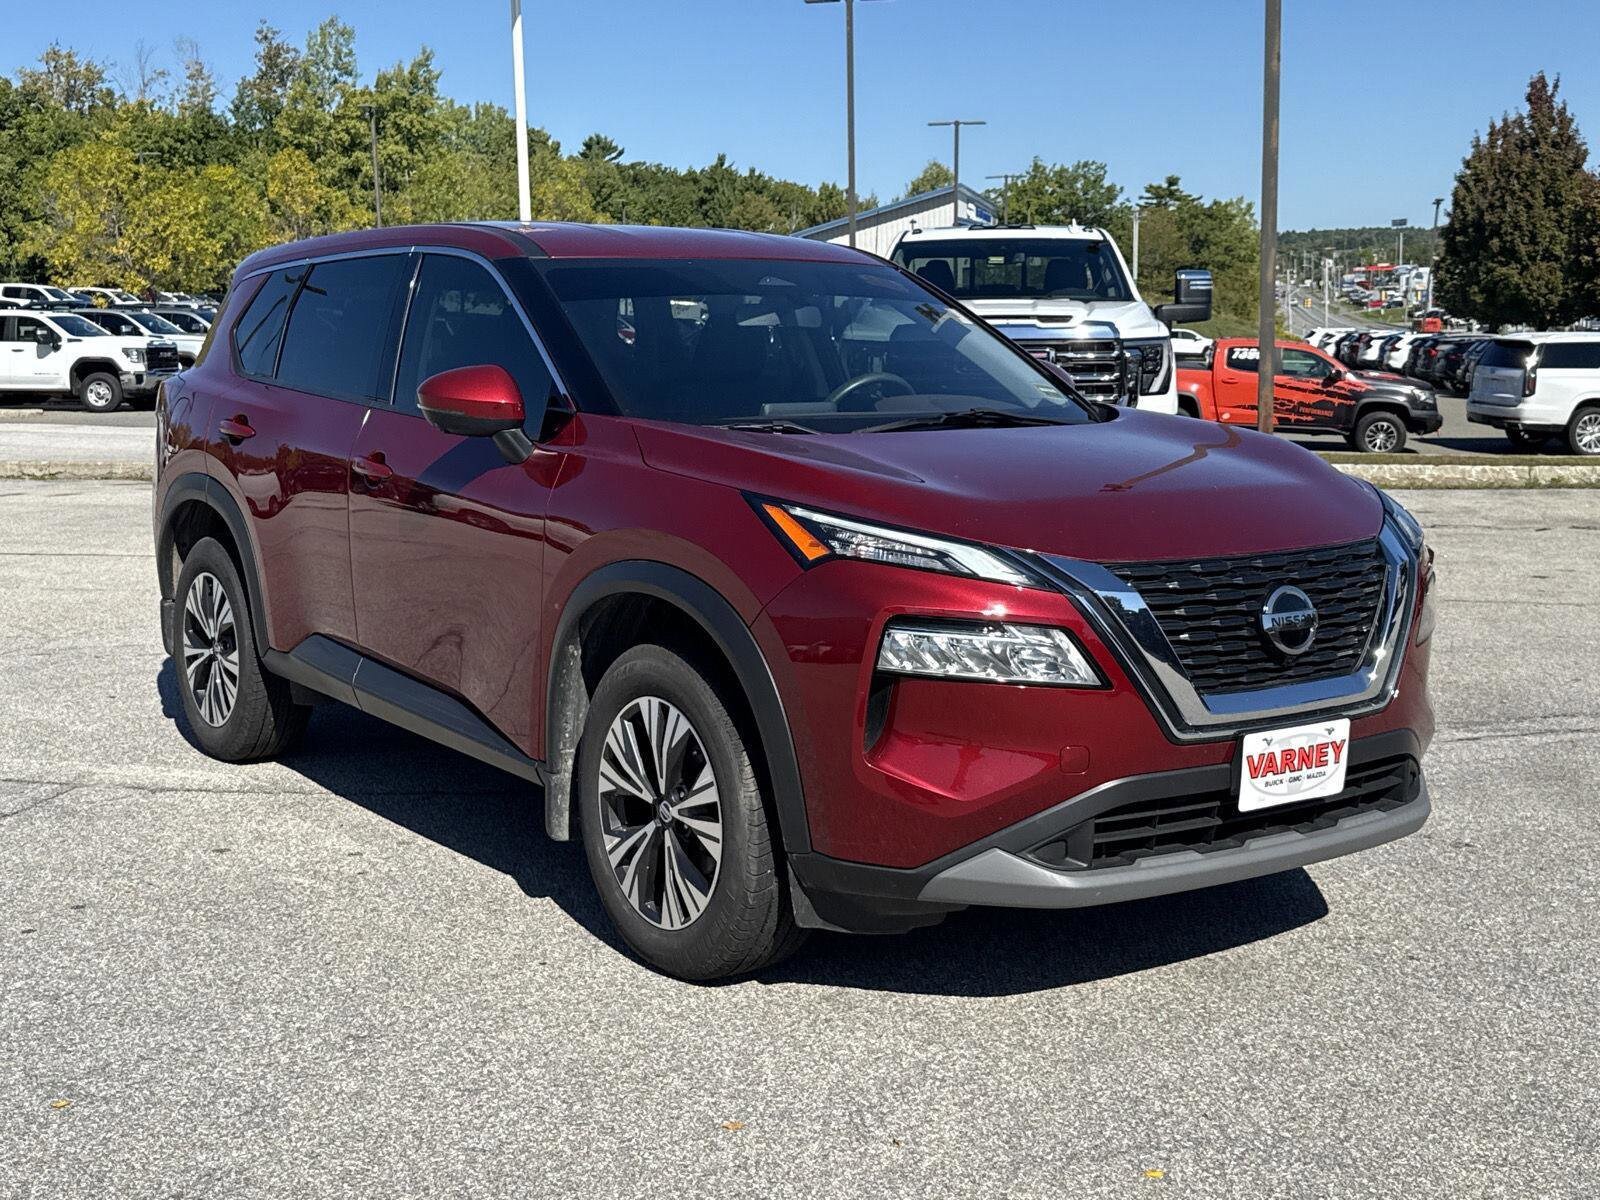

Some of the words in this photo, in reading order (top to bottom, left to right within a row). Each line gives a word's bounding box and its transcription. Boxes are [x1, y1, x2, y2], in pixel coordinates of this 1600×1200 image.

[1271, 612, 1315, 627] NISSAN
[1246, 739, 1346, 779] VARNEY
[1264, 779, 1284, 787] BUICK
[1288, 774, 1303, 783] GMC
[1306, 771, 1327, 779] MAZDA
